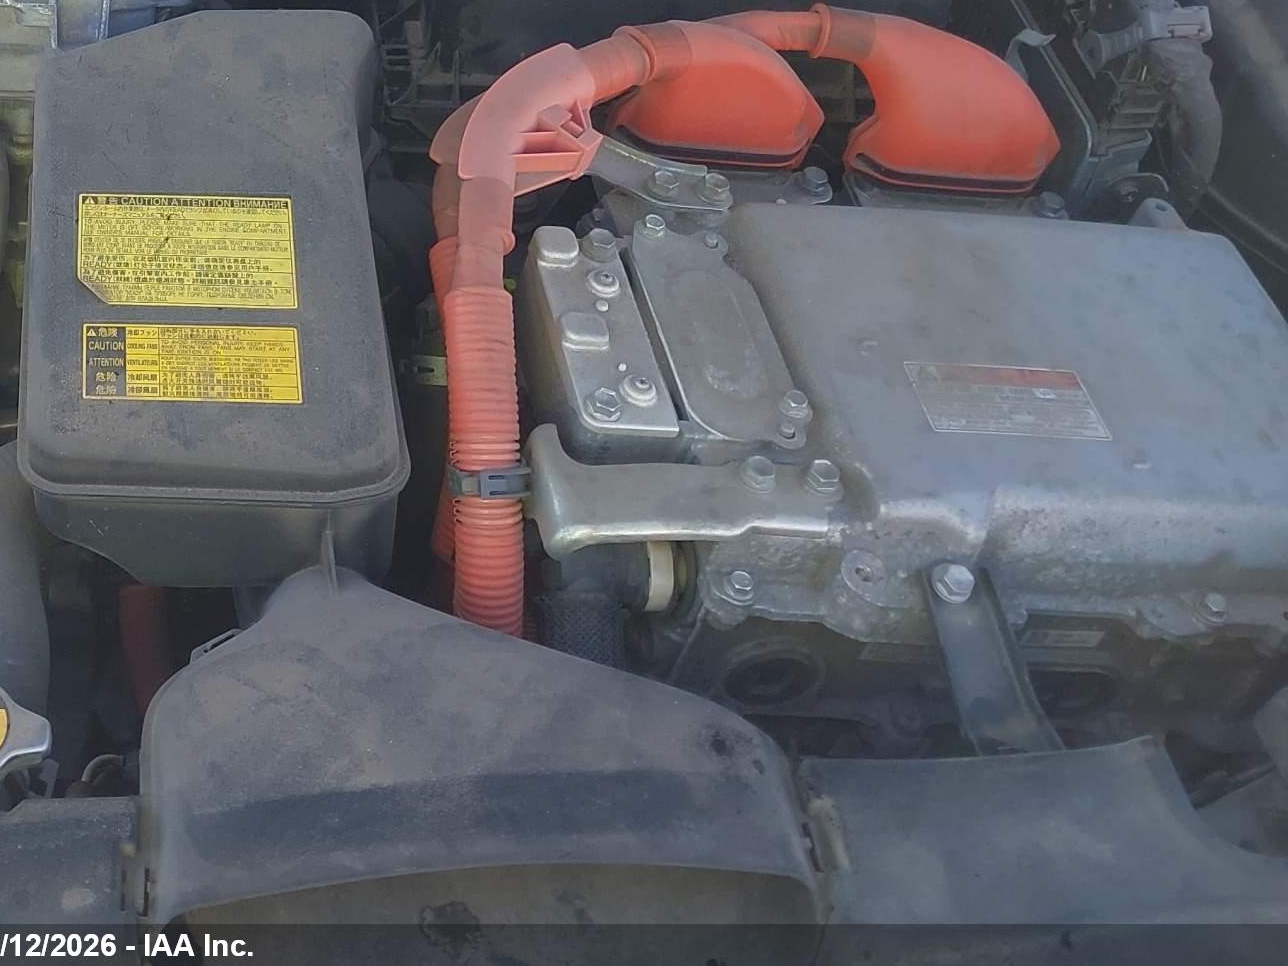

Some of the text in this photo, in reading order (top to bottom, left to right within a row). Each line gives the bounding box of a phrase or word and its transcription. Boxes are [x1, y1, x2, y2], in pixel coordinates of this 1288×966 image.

[121, 197, 168, 206] CAUTION
[170, 198, 230, 207] ATTENTION
[234, 200, 287, 209] ВНИМАНИЕ
[89, 341, 124, 351] CAUTION
[89, 358, 124, 367] ATTENTION
